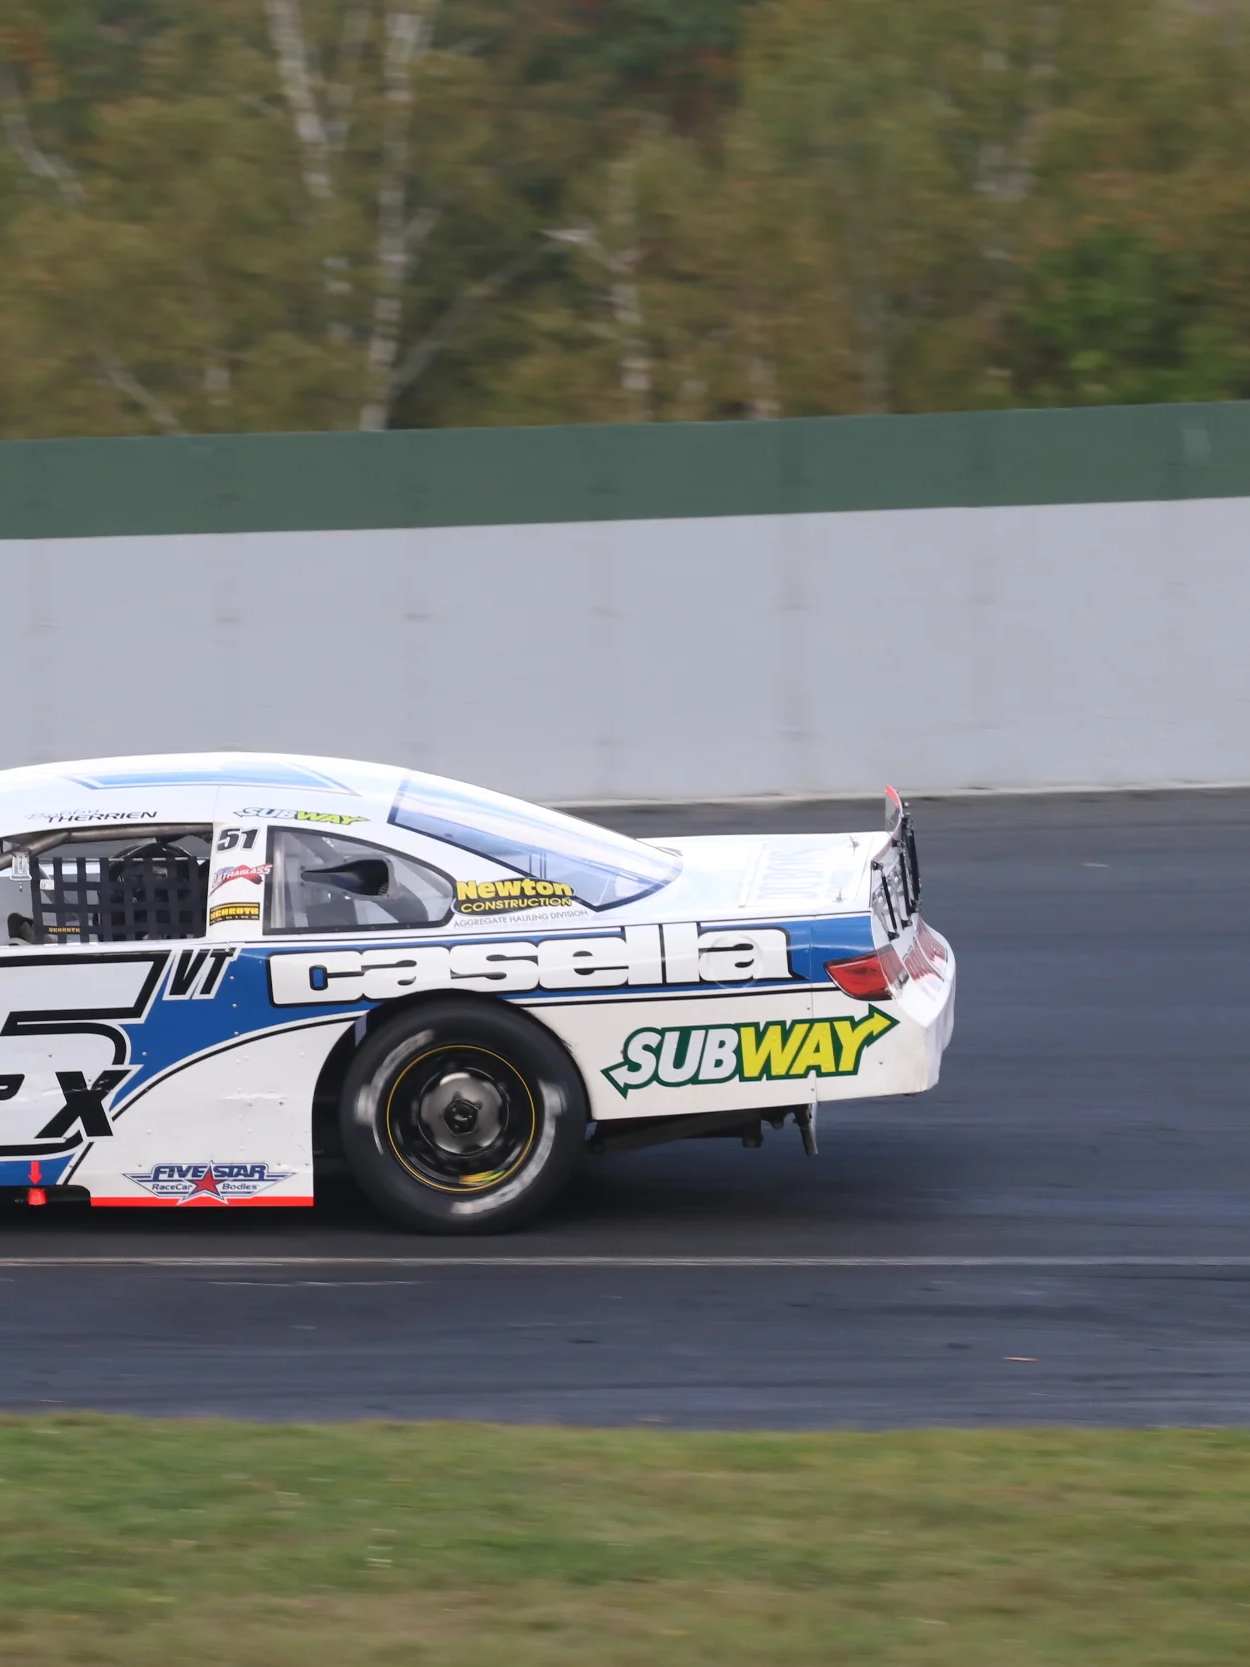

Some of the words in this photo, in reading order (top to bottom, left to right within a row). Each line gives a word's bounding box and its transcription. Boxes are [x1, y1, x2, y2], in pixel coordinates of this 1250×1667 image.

[48, 811, 158, 824] THERRIEN
[234, 806, 369, 825] SUBWAY
[217, 827, 260, 852] 51
[456, 878, 574, 901] Newton
[460, 897, 573, 913] CONSTRUCTION
[454, 915, 508, 928] AGGREGATE
[510, 912, 549, 923] HAULING
[550, 909, 589, 921] DIVISION
[169, 949, 235, 996] VT
[269, 922, 795, 1007] casella
[603, 1005, 897, 1096] SUBWAY
[152, 1165, 206, 1182] FIVE
[213, 1164, 267, 1182] STAR
[222, 1183, 258, 1191] Bodies
